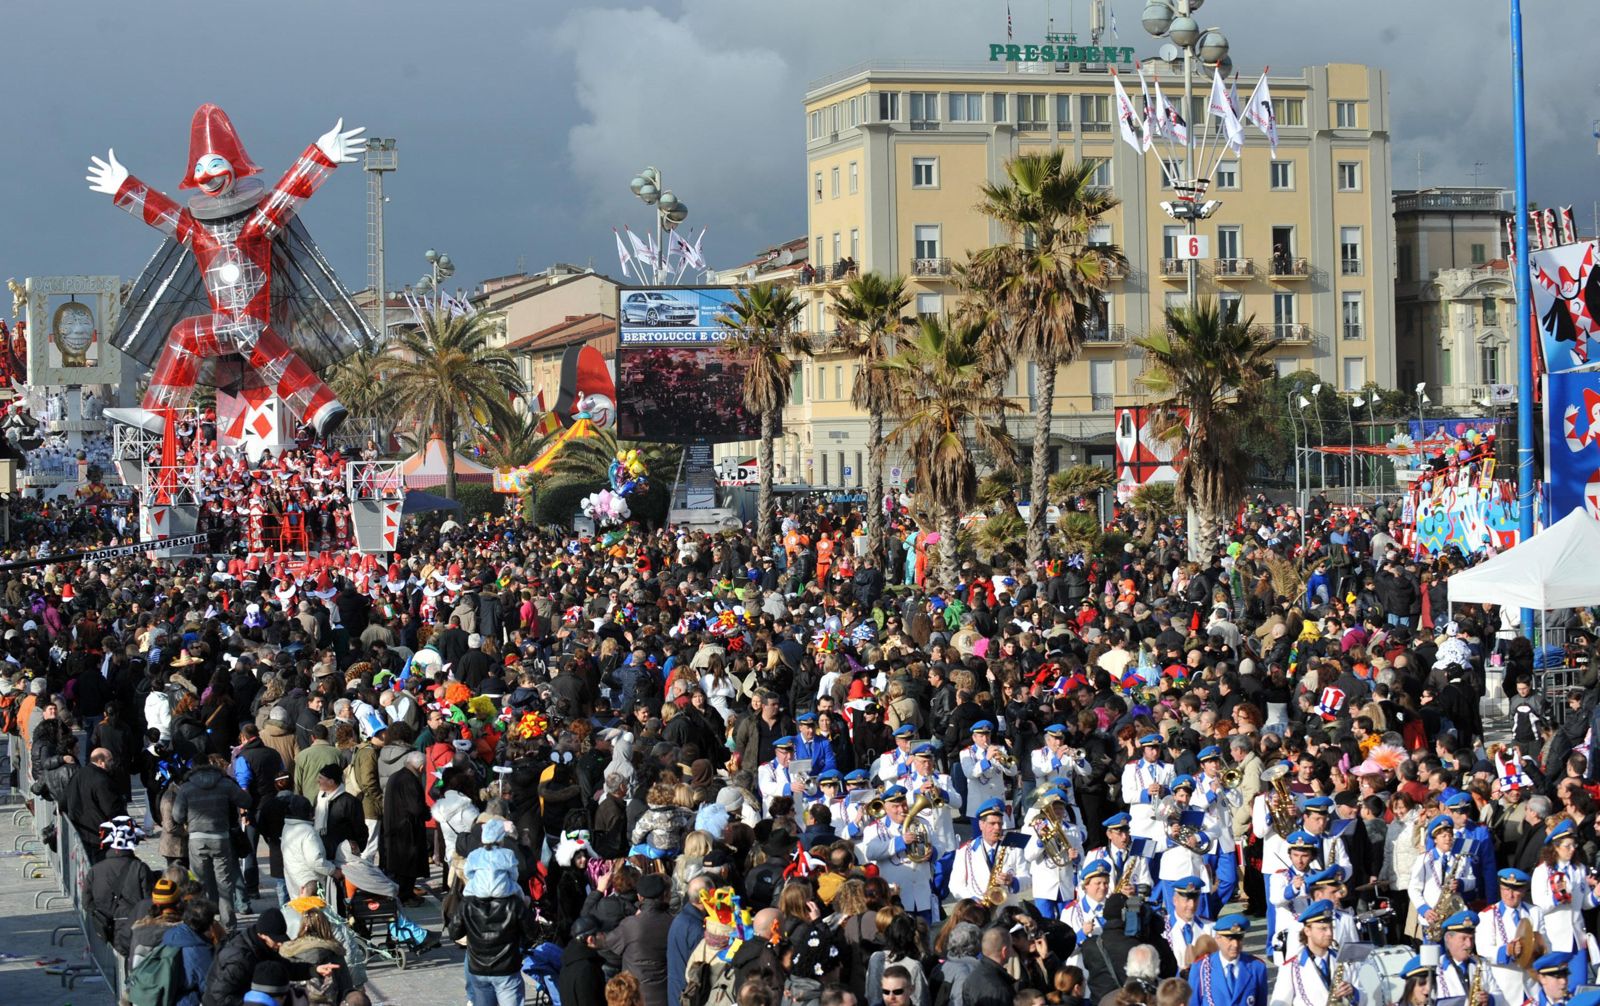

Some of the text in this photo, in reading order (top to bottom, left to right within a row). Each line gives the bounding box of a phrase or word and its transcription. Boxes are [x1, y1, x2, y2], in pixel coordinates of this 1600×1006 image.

[989, 43, 1135, 63] PRESIDENT
[1188, 237, 1199, 256] 6
[623, 332, 697, 342] BERTOLUCCI
[699, 332, 708, 341] E
[844, 468, 851, 476] P
[85, 550, 119, 561] RADIO
[132, 542, 156, 554] RETE
[160, 535, 206, 548] VERSILIA
